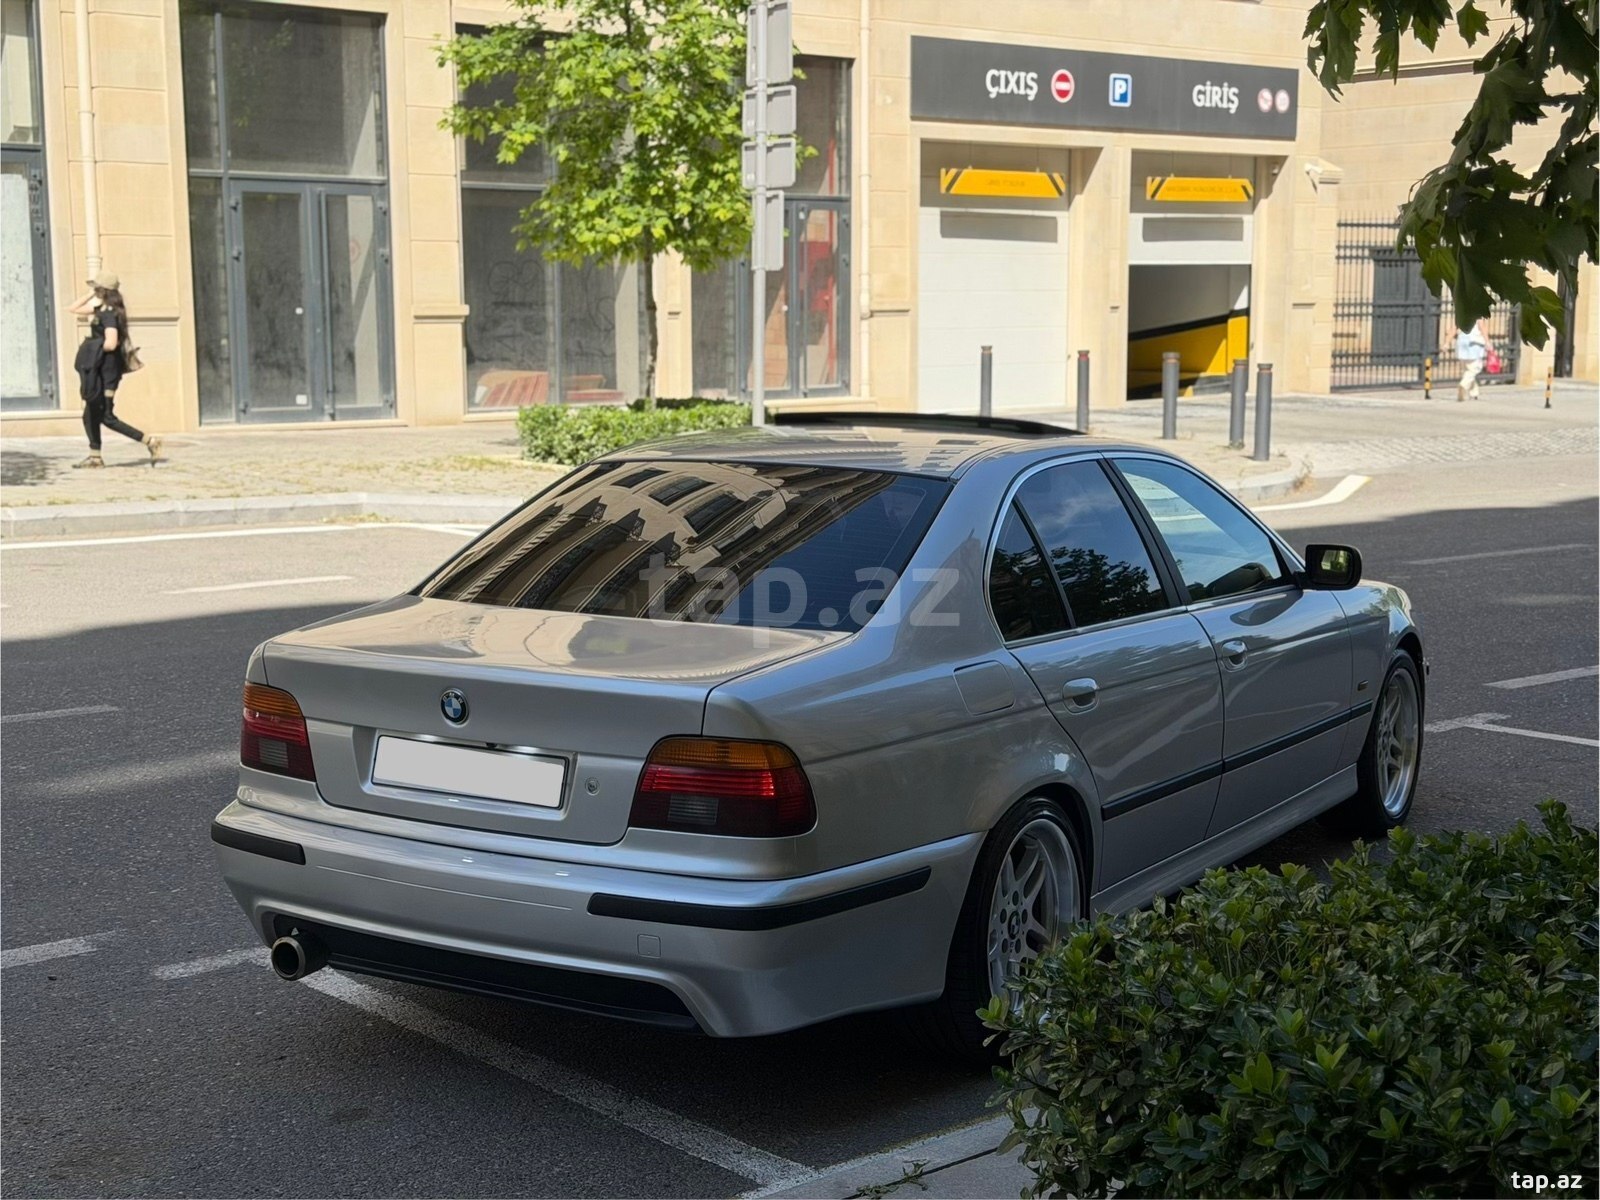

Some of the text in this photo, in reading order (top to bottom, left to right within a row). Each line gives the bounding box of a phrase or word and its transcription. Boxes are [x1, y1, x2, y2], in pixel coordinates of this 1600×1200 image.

[985, 69, 1038, 101] ÇIXIŞ
[1114, 79, 1127, 101] P
[1192, 80, 1239, 114] GİRİŞ
